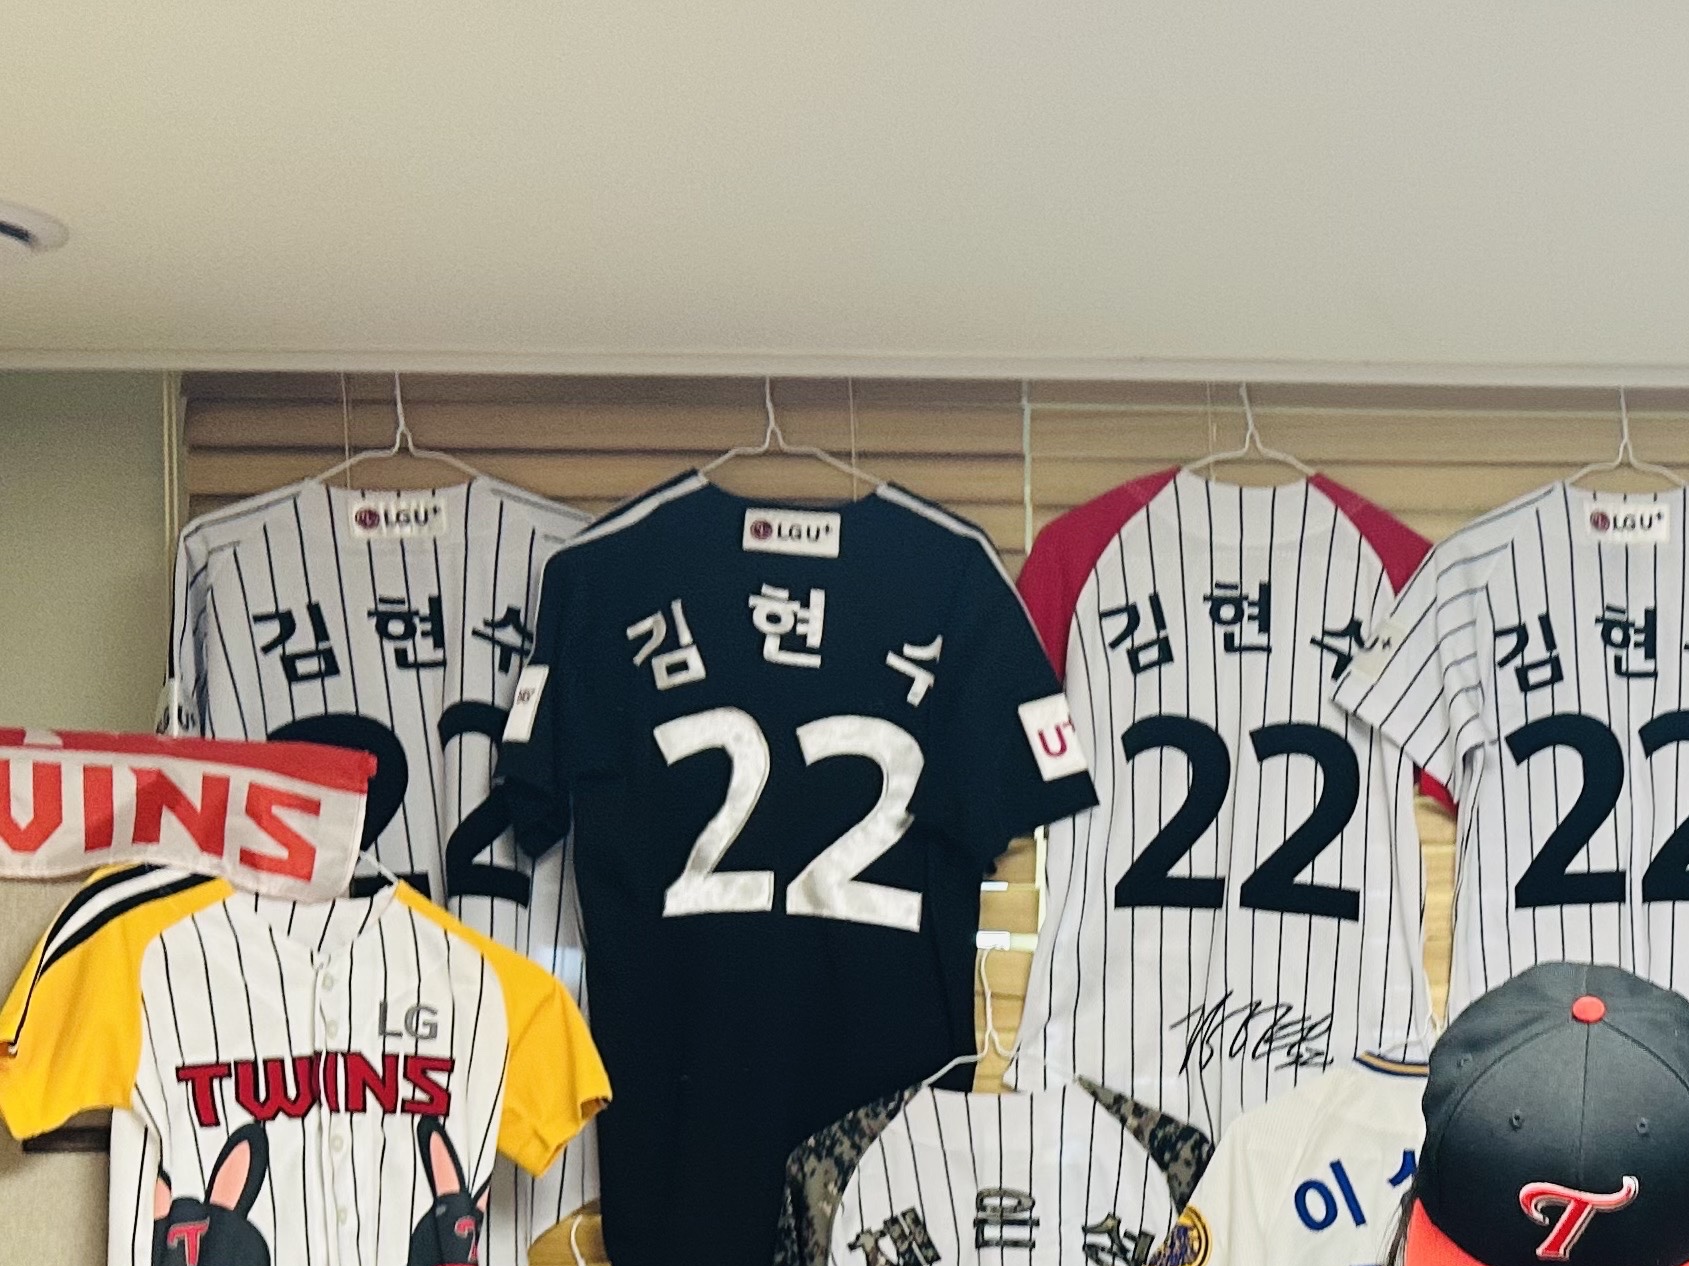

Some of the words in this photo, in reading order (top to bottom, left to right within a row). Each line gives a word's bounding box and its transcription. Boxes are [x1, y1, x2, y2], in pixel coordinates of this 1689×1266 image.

[626, 582, 944, 706] 김현수
[653, 706, 924, 933] 22
[1114, 714, 1361, 922] 22
[378, 1000, 439, 1042] LG
[176, 1049, 456, 1128] TWINS
